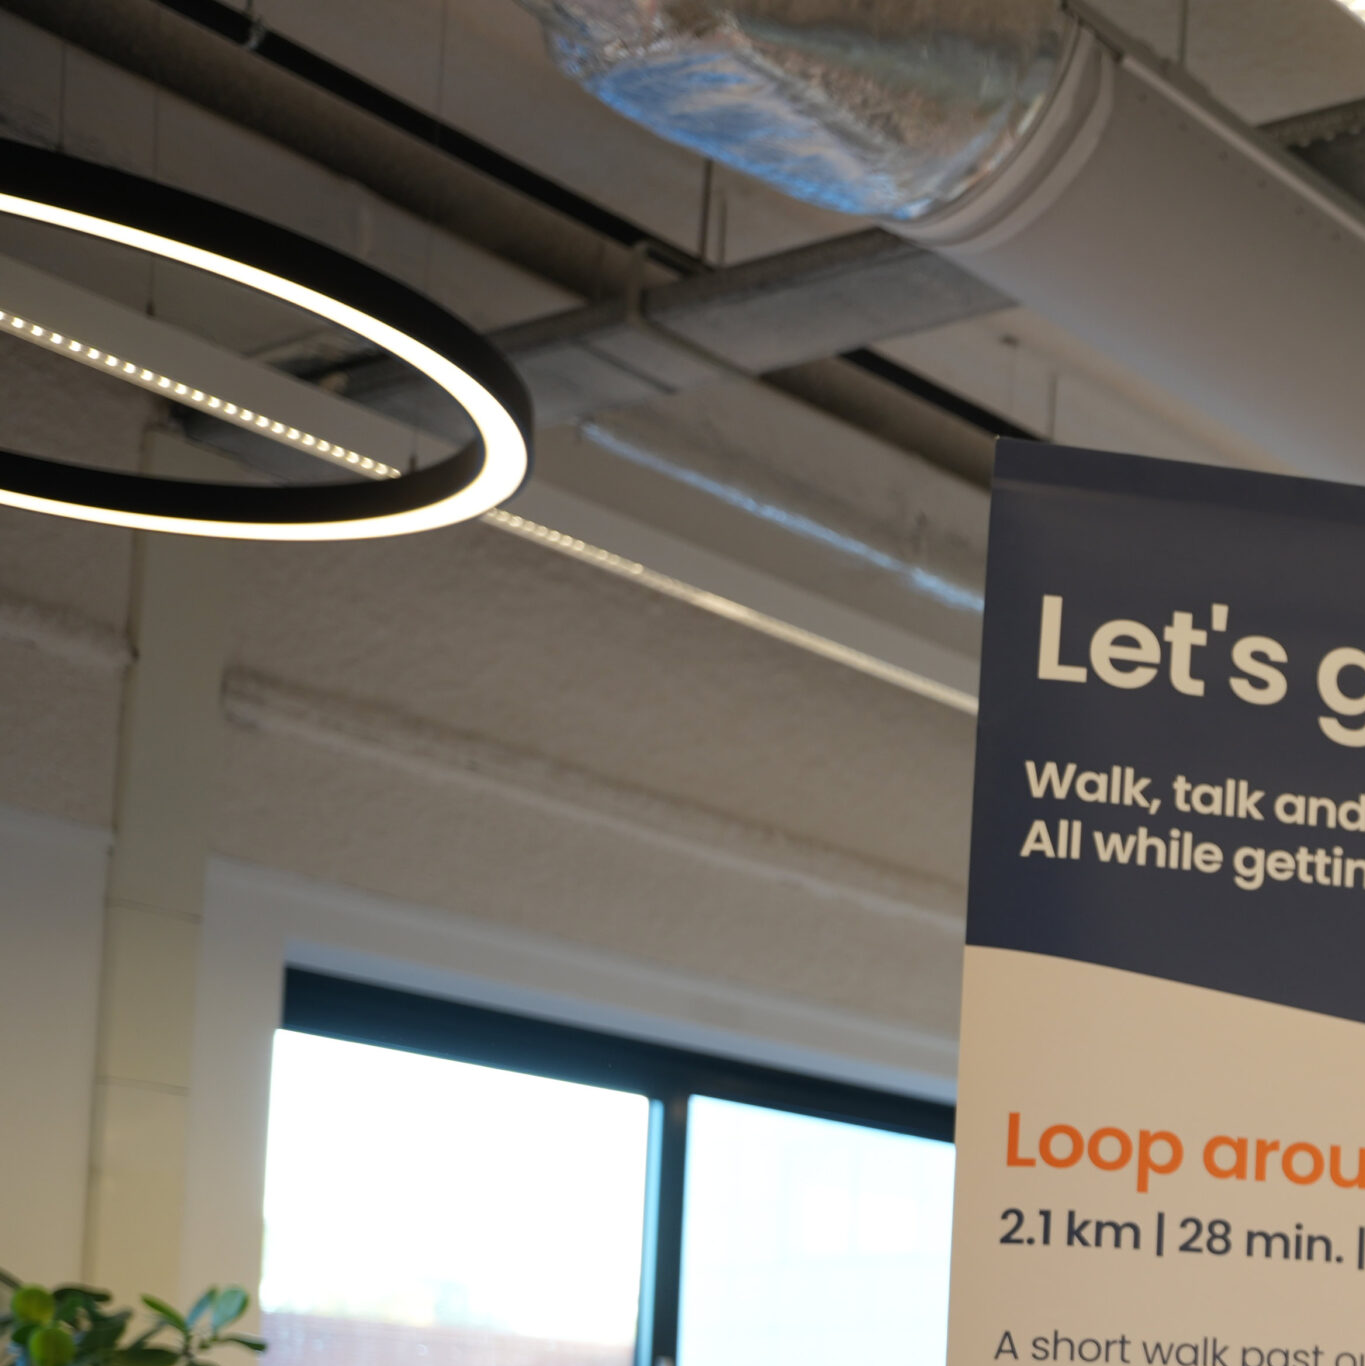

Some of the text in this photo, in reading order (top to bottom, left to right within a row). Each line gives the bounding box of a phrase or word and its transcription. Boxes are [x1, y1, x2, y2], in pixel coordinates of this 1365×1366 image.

[1037, 594, 1288, 705] Let's
[1024, 760, 1162, 815] Walk,
[1172, 775, 1265, 821] talk
[1020, 818, 1082, 860] All
[1093, 826, 1224, 874] while
[1006, 1111, 1184, 1194] Loop
[999, 1207, 1052, 1246] 2.1
[1066, 1209, 1141, 1250] km
[1178, 1216, 1232, 1256] 28
[1246, 1222, 1344, 1264] min.
[993, 1330, 1019, 1361] A
[1031, 1329, 1132, 1365] short
